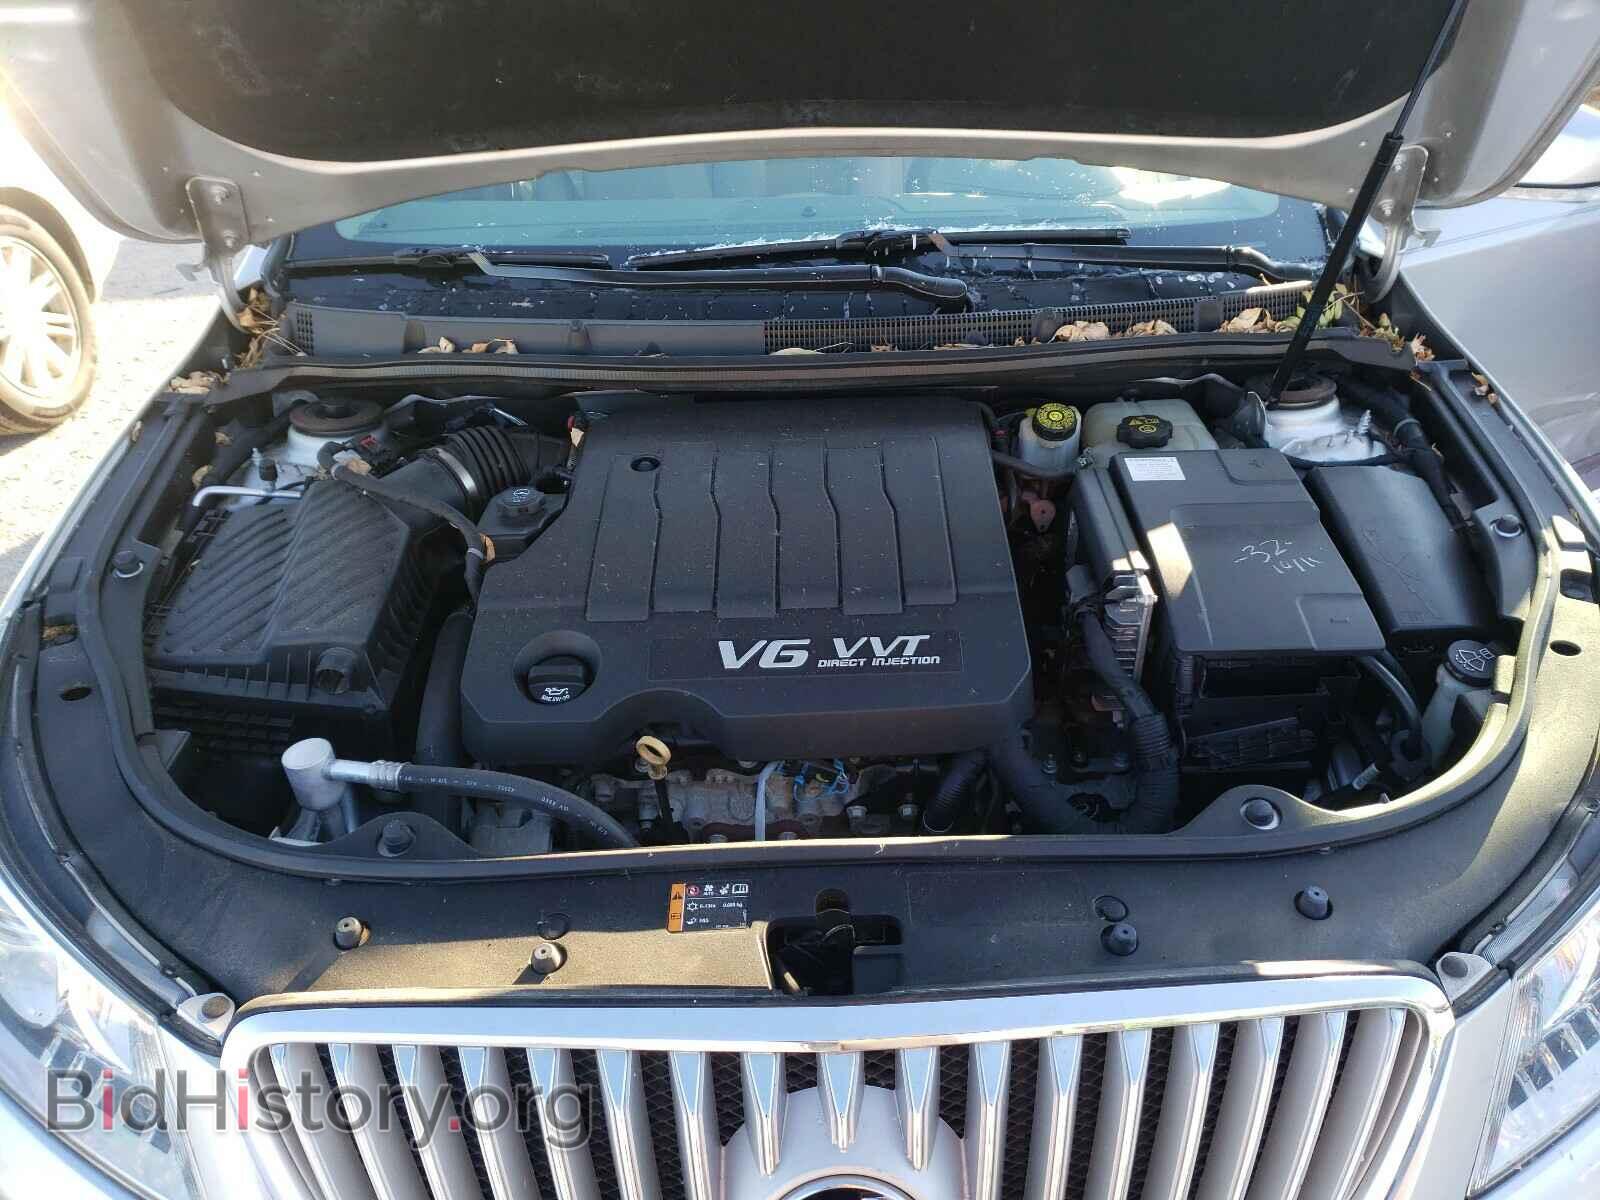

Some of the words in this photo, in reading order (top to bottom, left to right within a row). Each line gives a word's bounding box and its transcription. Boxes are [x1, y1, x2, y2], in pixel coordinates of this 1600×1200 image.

[718, 638, 811, 669] V6
[833, 634, 930, 658] VVT
[818, 658, 866, 667] DIRECT
[872, 655, 940, 665] INJECTION
